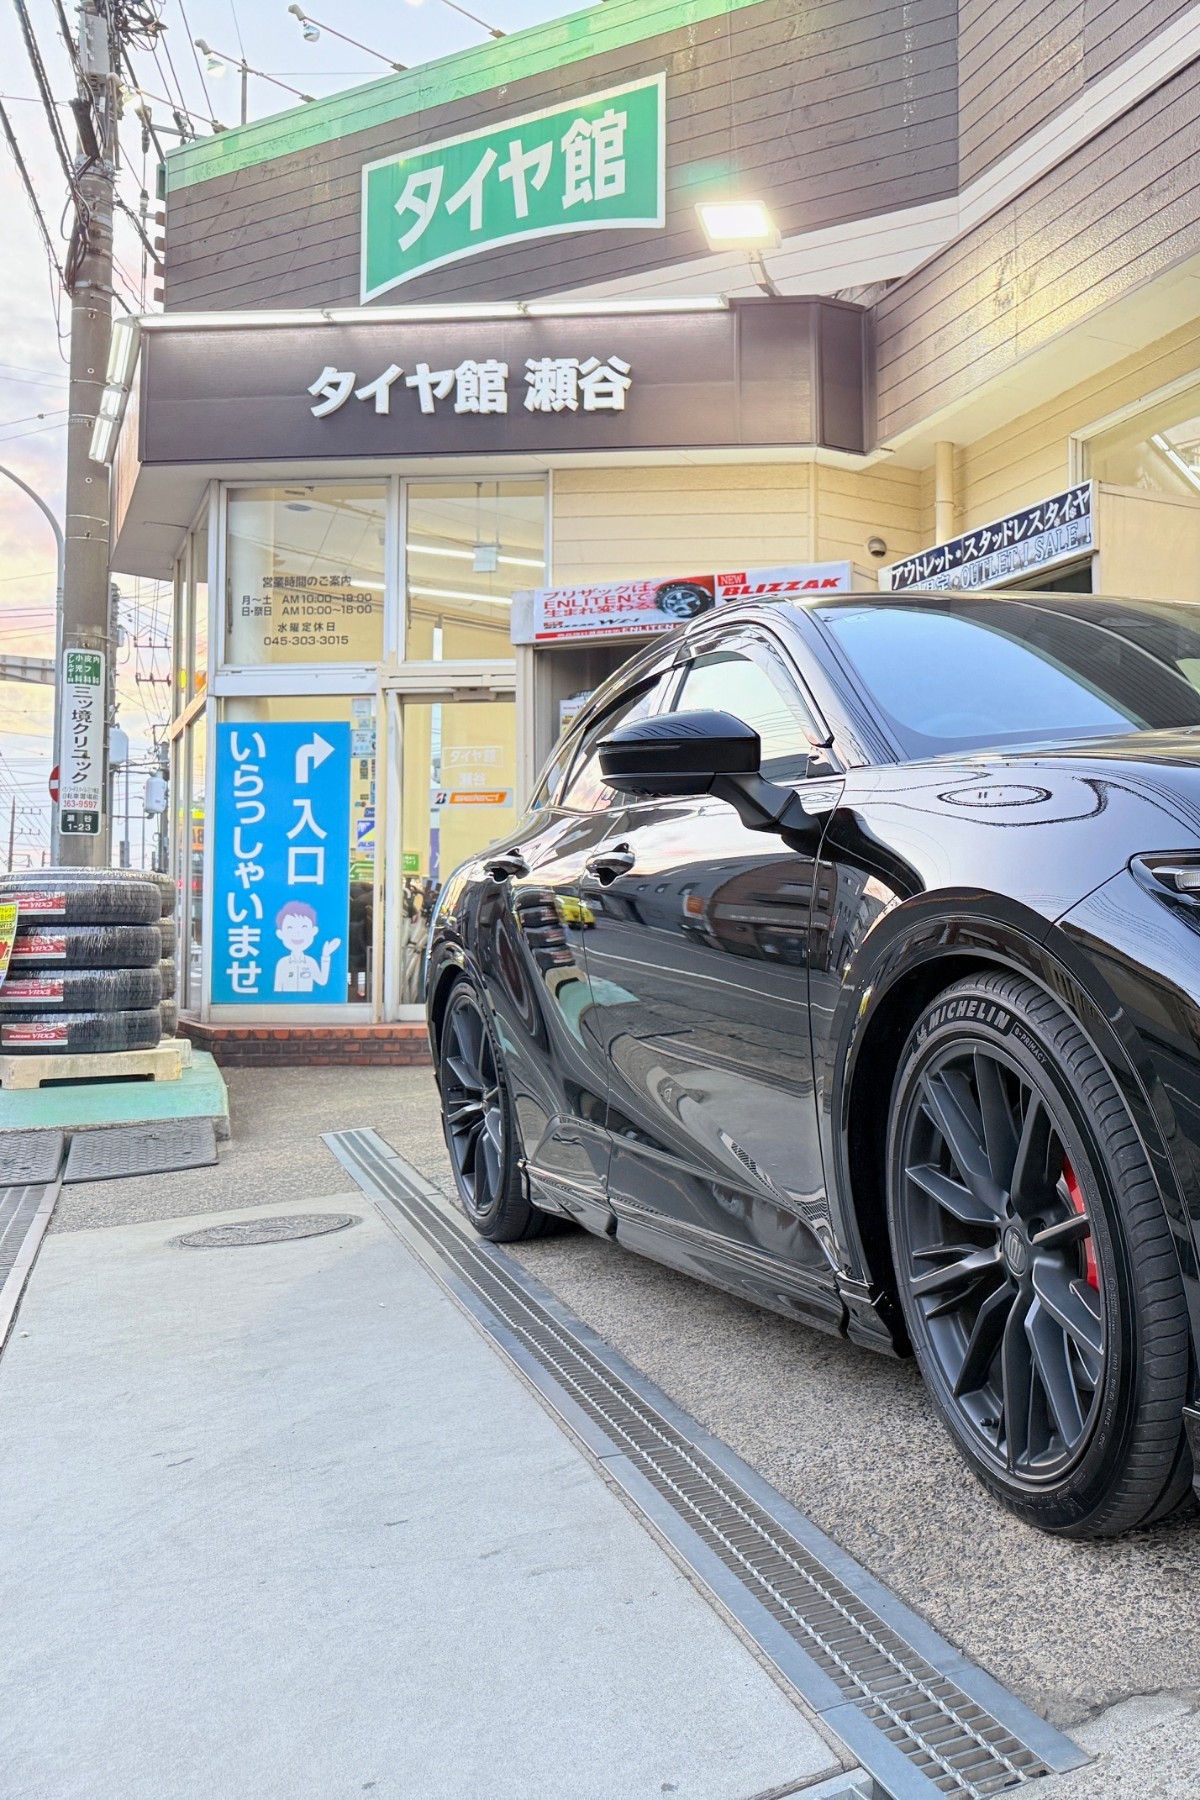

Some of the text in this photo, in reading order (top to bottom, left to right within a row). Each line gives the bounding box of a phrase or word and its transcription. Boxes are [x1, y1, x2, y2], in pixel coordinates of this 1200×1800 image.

[394, 108, 628, 252] タイヤ館
[307, 355, 632, 417] タイヤ館 瀬谷
[892, 489, 1090, 590] アウトレット・スタッドレスタイヤ
[263, 576, 352, 588] 営業時間のご案内
[720, 575, 743, 585] NEW
[722, 577, 842, 597] BLIZZAK
[277, 622, 336, 632] 水曜定休日
[264, 636, 349, 646] 045-303-3015
[68, 823, 91, 831] 1-23
[286, 798, 327, 885] 入口
[226, 731, 266, 994] いらっしゃいませ
[928, 1000, 1011, 1031] MICHELIN
